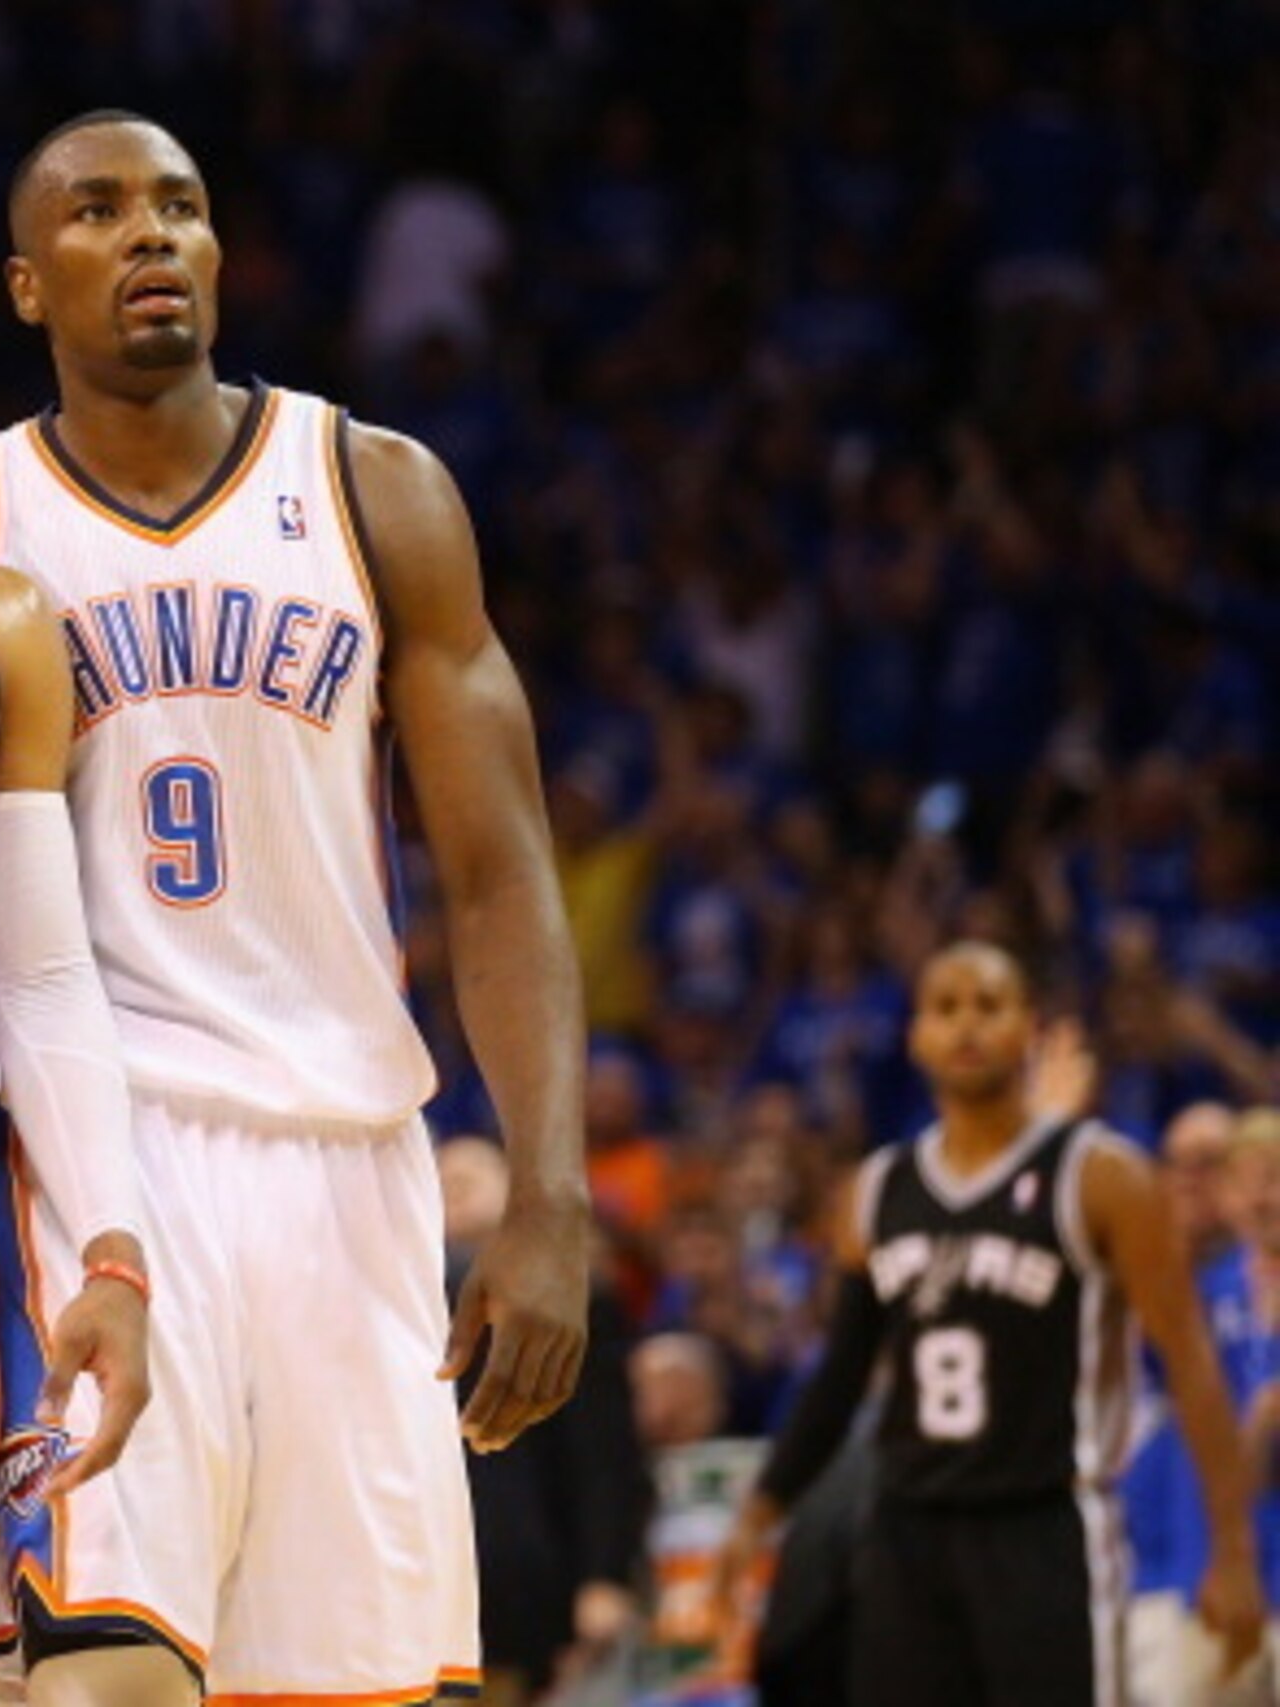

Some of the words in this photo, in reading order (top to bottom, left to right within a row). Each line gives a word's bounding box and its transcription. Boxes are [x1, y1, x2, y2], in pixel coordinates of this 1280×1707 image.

[64, 578, 361, 738] HUNDER
[140, 755, 228, 909] 9
[912, 1324, 988, 1441] 8
